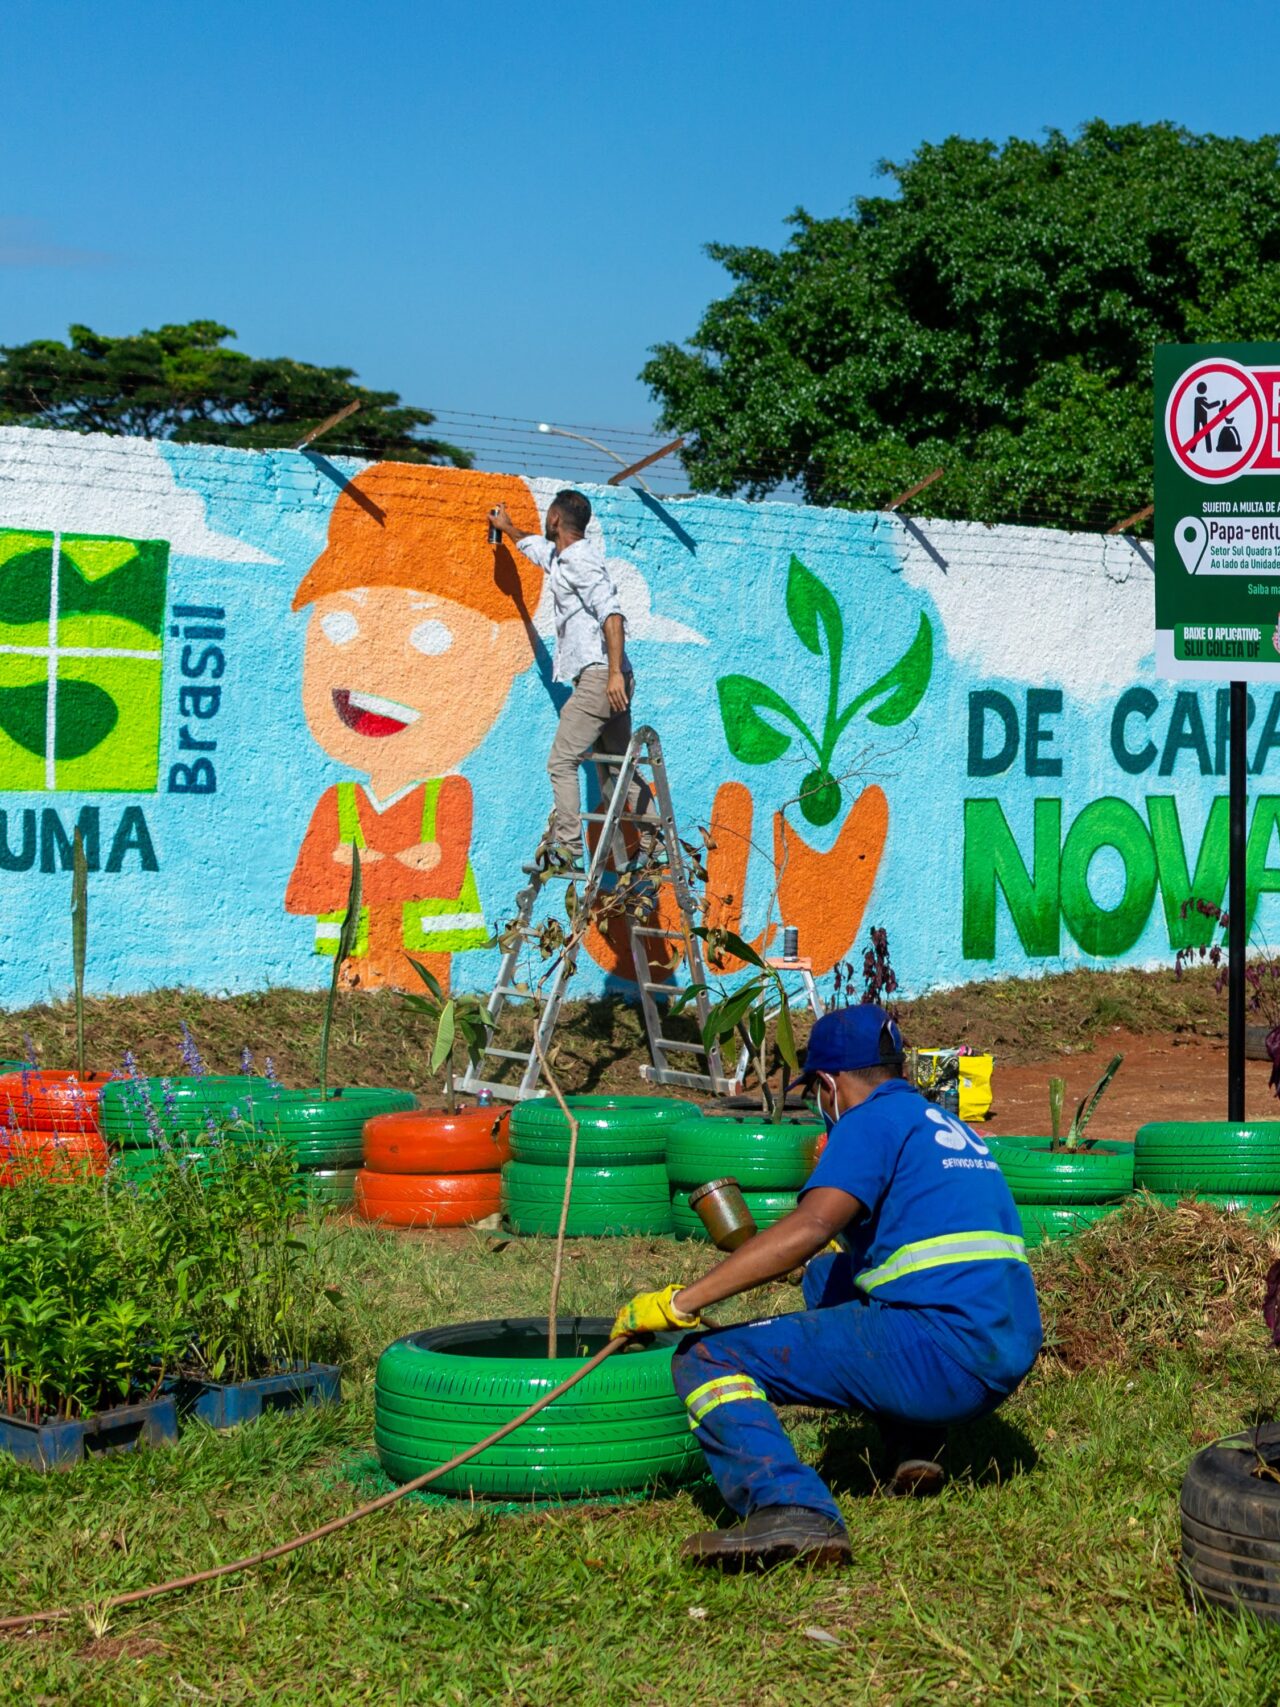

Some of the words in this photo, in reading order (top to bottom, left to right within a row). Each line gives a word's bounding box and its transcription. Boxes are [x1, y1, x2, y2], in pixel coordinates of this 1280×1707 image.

[1202, 501, 1231, 513] SUJEITO
[1232, 502, 1239, 512] A
[1240, 502, 1264, 513] MULTA
[1266, 502, 1275, 512] DE
[1211, 546, 1230, 556] Setor
[1232, 546, 1244, 556] Sul
[1246, 546, 1272, 557] Quadra
[1211, 559, 1220, 569] Ao
[1222, 559, 1238, 569] lado
[1240, 559, 1249, 569] da
[1251, 559, 1280, 569] Unidade
[1248, 583, 1269, 595] Saiba
[1184, 627, 1206, 640] BAIXE
[1207, 627, 1213, 640] O
[1215, 627, 1261, 641] APLICATIVO:
[1184, 640, 1203, 657] SLU
[1206, 641, 1244, 658] COLETA
[1247, 641, 1260, 658] DF
[168, 605, 226, 794] Brasil
[967, 688, 1063, 777] DE
[0, 806, 159, 873] UMA
